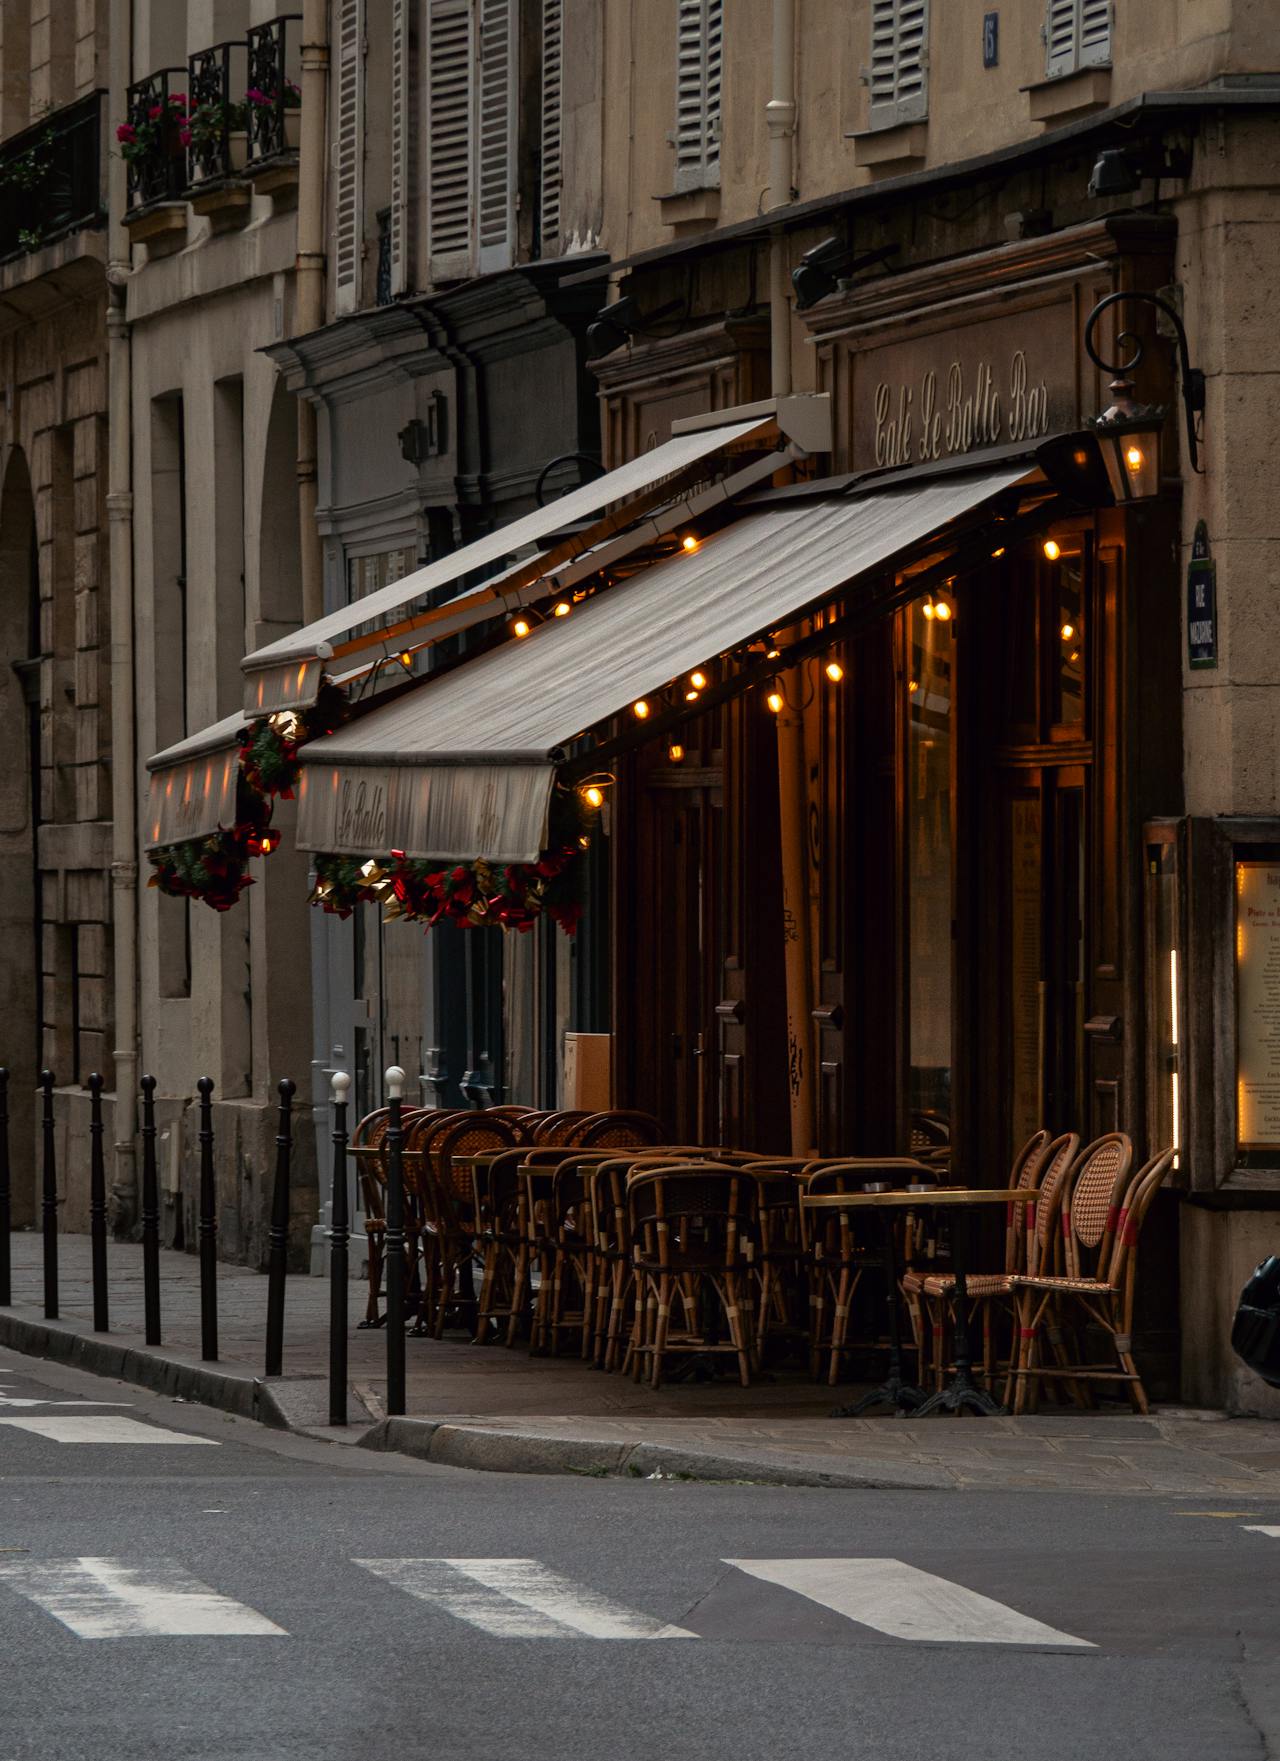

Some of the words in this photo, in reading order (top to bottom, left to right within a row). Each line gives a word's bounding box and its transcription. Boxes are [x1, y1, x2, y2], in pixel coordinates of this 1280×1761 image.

[874, 382, 912, 467] Café
[919, 370, 942, 460] Le
[946, 362, 1001, 453] Balto
[1009, 350, 1049, 441] Bar
[1195, 584, 1205, 607] RUE
